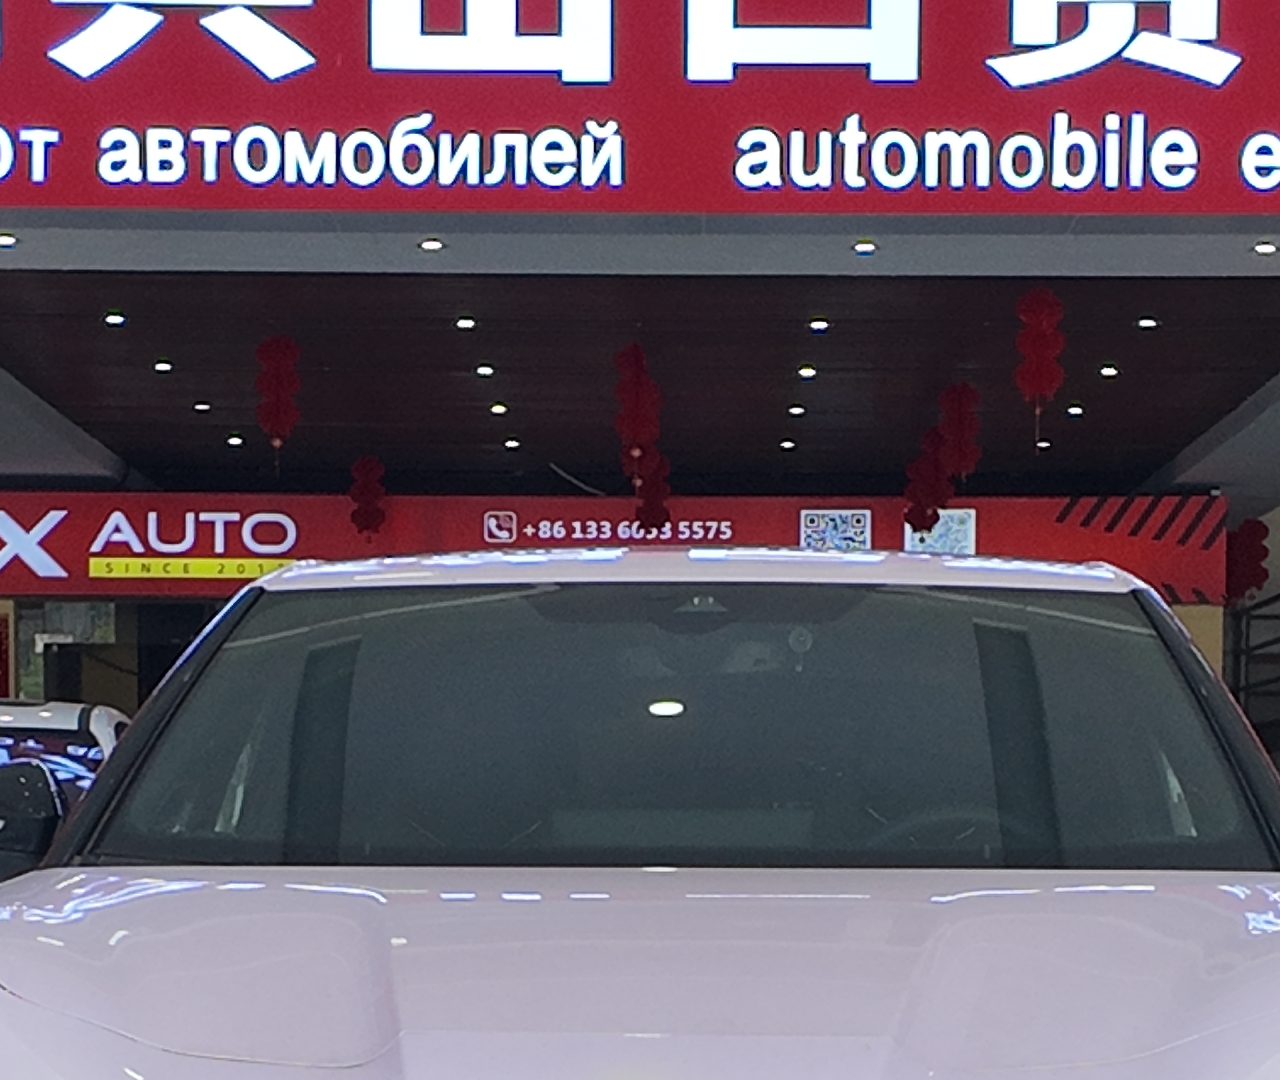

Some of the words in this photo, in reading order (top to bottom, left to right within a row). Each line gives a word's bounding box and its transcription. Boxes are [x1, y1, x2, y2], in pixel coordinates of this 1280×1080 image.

[98, 113, 622, 187] автомобилей
[735, 112, 1198, 190] automobile
[89, 510, 297, 555] AUTO
[522, 520, 567, 540] +86
[571, 520, 612, 540] 133
[678, 520, 733, 540] 5575
[105, 562, 190, 575] SINCE
[216, 562, 285, 575] 201
